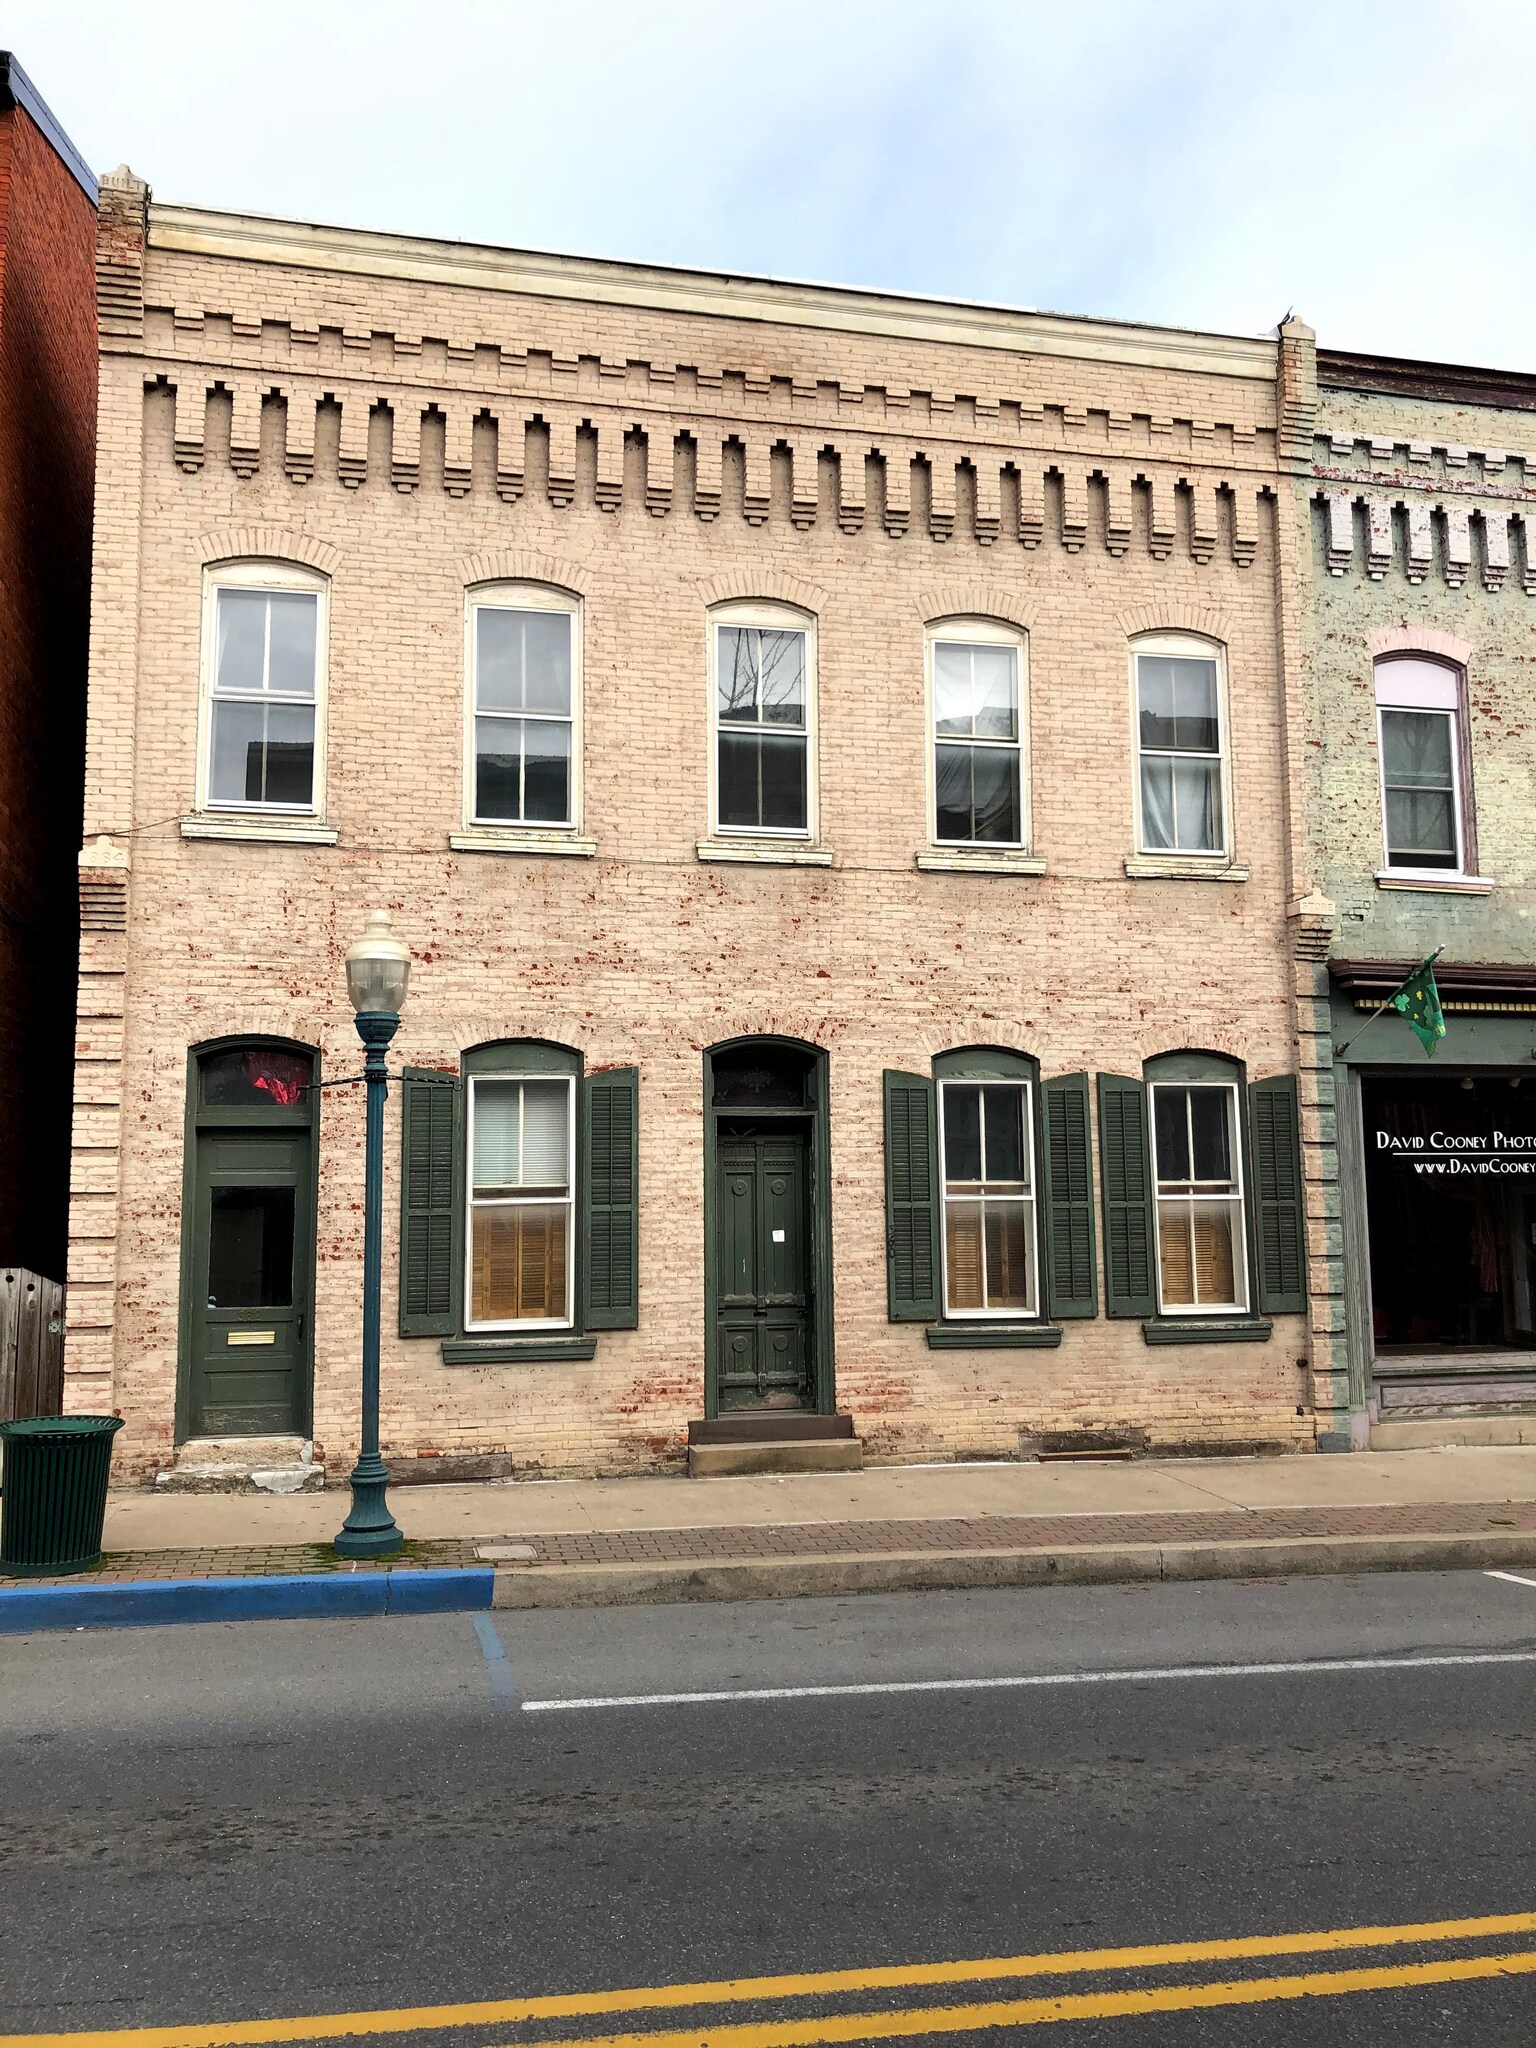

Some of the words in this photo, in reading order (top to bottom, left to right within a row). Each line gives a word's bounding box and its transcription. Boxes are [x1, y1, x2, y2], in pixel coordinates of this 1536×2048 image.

[101, 175, 144, 190] BUILT
[1301, 901, 1334, 911] STORE
[1376, 1131, 1424, 1149] DAVID
[1430, 1131, 1488, 1149] COONEY
[1493, 1131, 1536, 1149] PHOT
